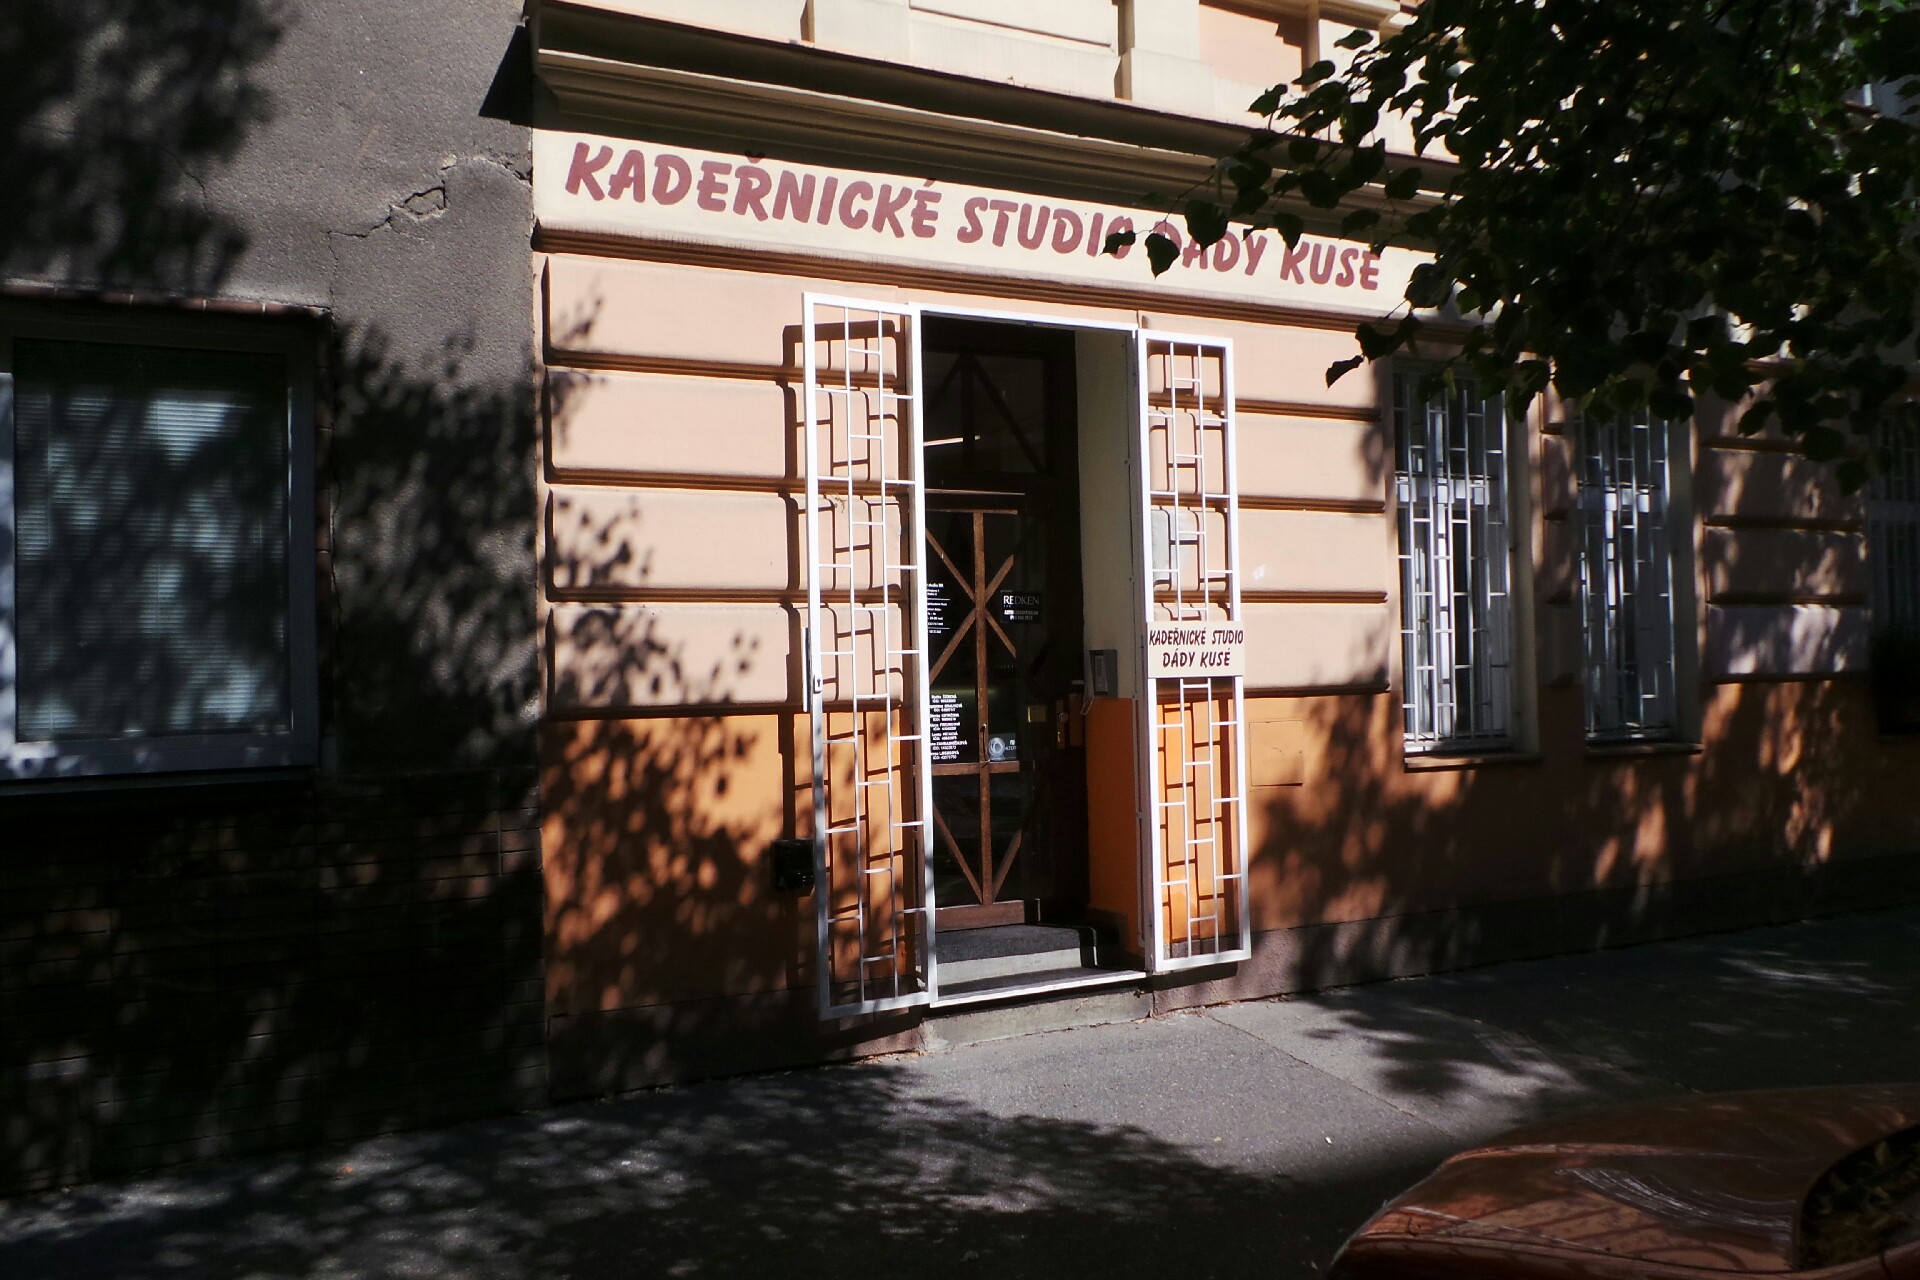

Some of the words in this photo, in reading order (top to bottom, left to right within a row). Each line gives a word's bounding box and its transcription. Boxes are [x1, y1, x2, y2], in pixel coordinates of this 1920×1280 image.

[565, 142, 942, 239] KADEŘNICKÉ
[957, 197, 1134, 259] STUDIO
[1149, 627, 1206, 646] KADEŘNICKÉ
[1212, 629, 1244, 645] STUDIO
[1162, 648, 1196, 668] DÁDY
[1200, 648, 1231, 668] KUSÉ
